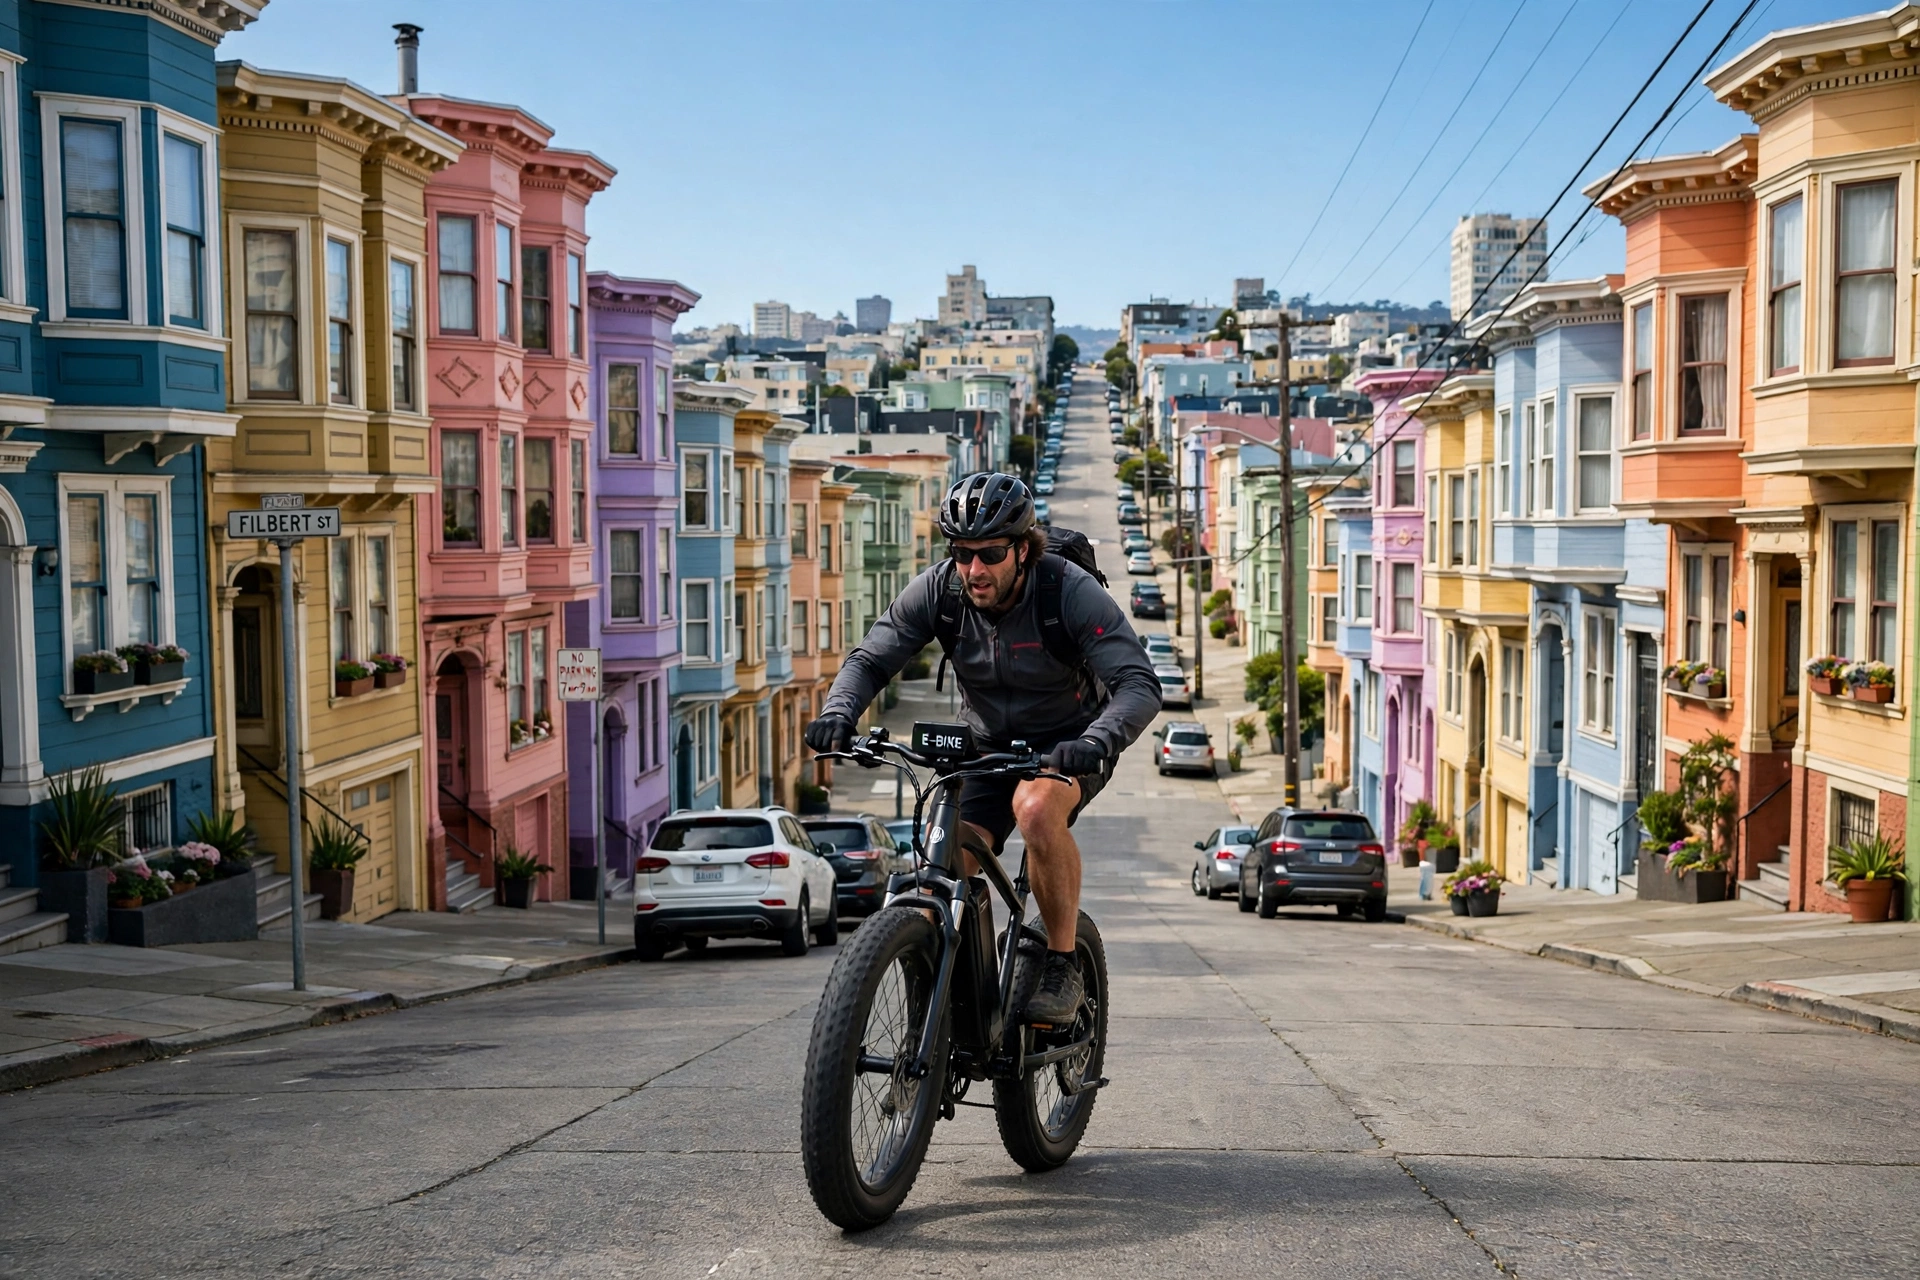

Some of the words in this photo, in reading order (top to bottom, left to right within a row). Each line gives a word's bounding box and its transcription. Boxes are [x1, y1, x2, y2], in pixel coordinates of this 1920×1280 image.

[240, 514, 311, 533] FILBERT
[317, 515, 331, 529] ST
[571, 652, 584, 663] NO
[921, 732, 963, 750] E-BIKE
